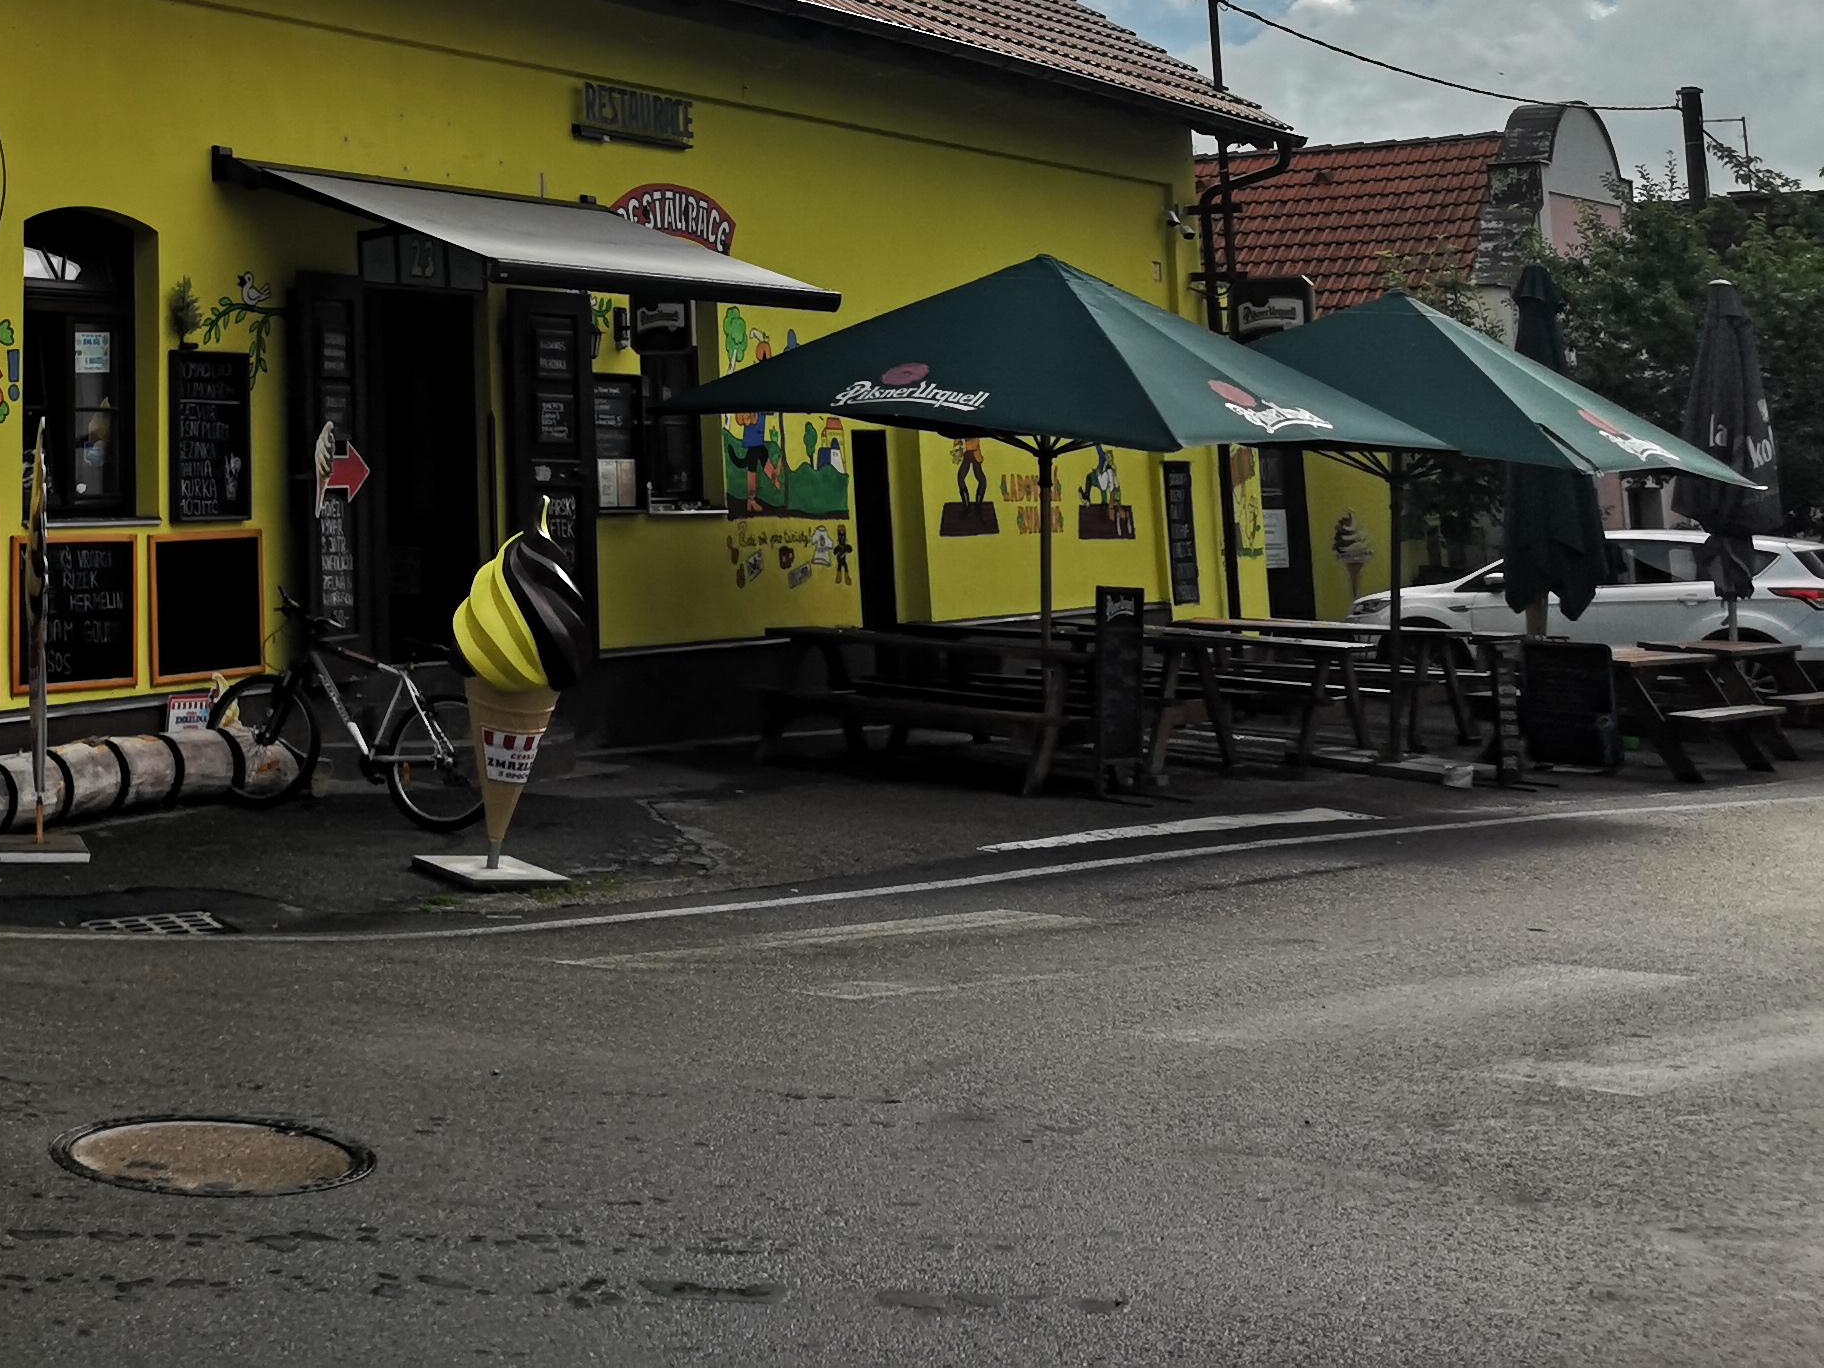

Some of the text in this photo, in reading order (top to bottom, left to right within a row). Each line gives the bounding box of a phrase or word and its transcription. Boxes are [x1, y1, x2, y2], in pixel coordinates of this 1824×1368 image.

[583, 82, 694, 139] RESTAURACE
[830, 380, 990, 409] Pilsner Urquell
